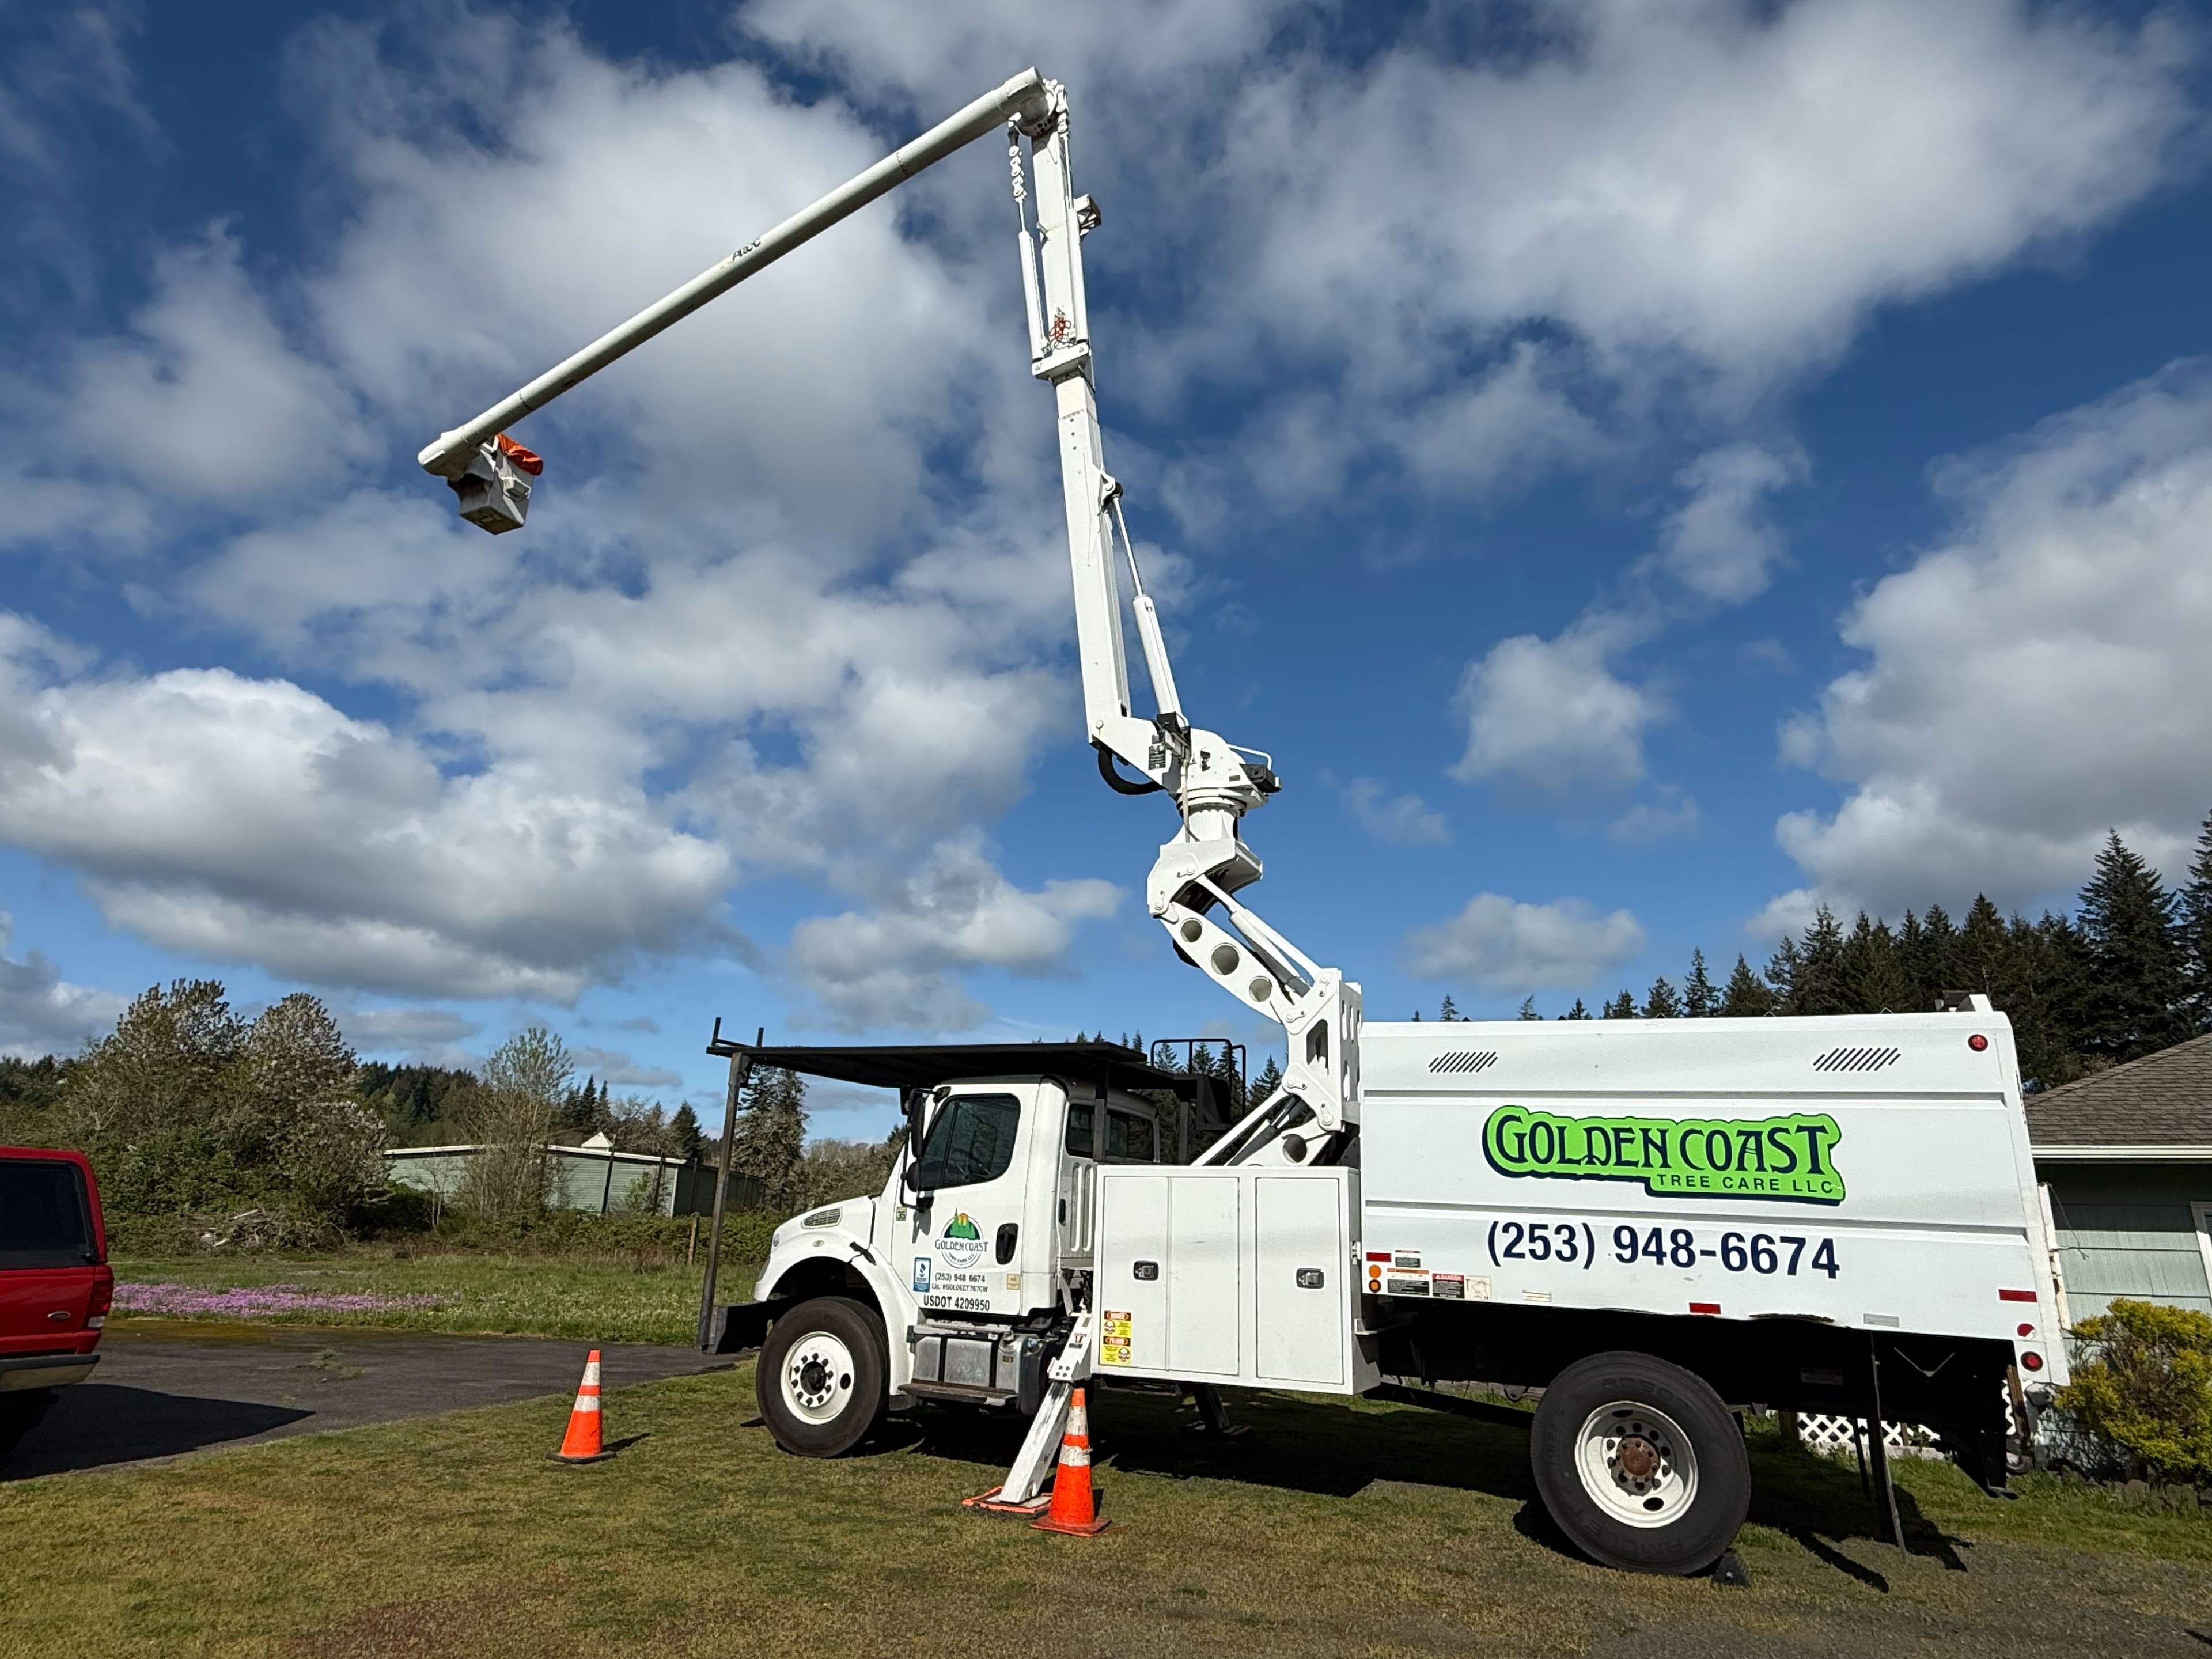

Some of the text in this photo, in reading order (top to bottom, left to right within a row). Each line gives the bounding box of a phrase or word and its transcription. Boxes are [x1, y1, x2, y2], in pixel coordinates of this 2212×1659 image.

[1498, 1114, 1829, 1175] GOLDEN COAST
[1658, 1173, 1834, 1194] TREE CARE LLC
[897, 1211, 906, 1219] 35
[935, 1239, 988, 1252] GOLDEN COAST
[1488, 1221, 1840, 1279] (253) 948-6674
[935, 1272, 952, 1282] (253)
[954, 1274, 966, 1282] 948
[969, 1274, 986, 1283] 6674
[923, 1294, 990, 1312] USDOT 4209950
